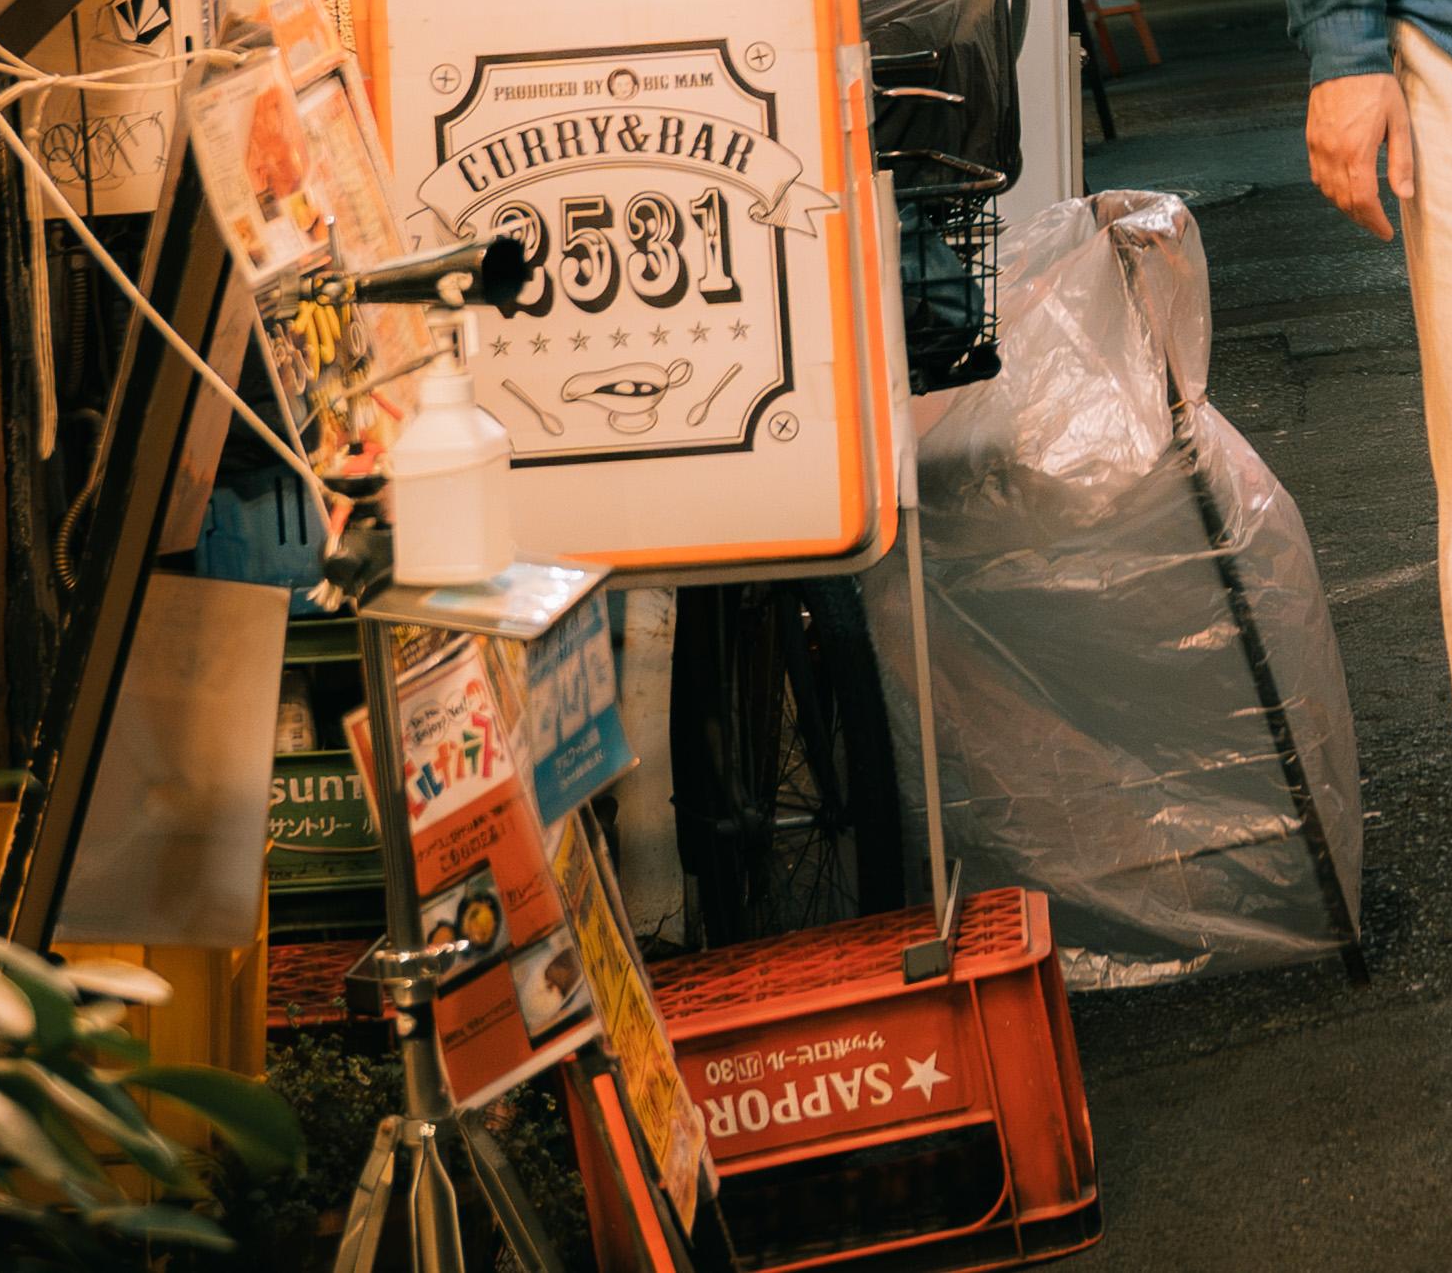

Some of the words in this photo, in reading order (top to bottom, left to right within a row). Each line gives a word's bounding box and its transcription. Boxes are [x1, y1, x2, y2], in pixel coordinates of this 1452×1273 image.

[582, 80, 604, 95] BY
[643, 74, 670, 91] BIG
[674, 72, 714, 88] MAM
[458, 113, 756, 193] CURRY&BAR
[767, 1034, 885, 1070] サッポロビール
